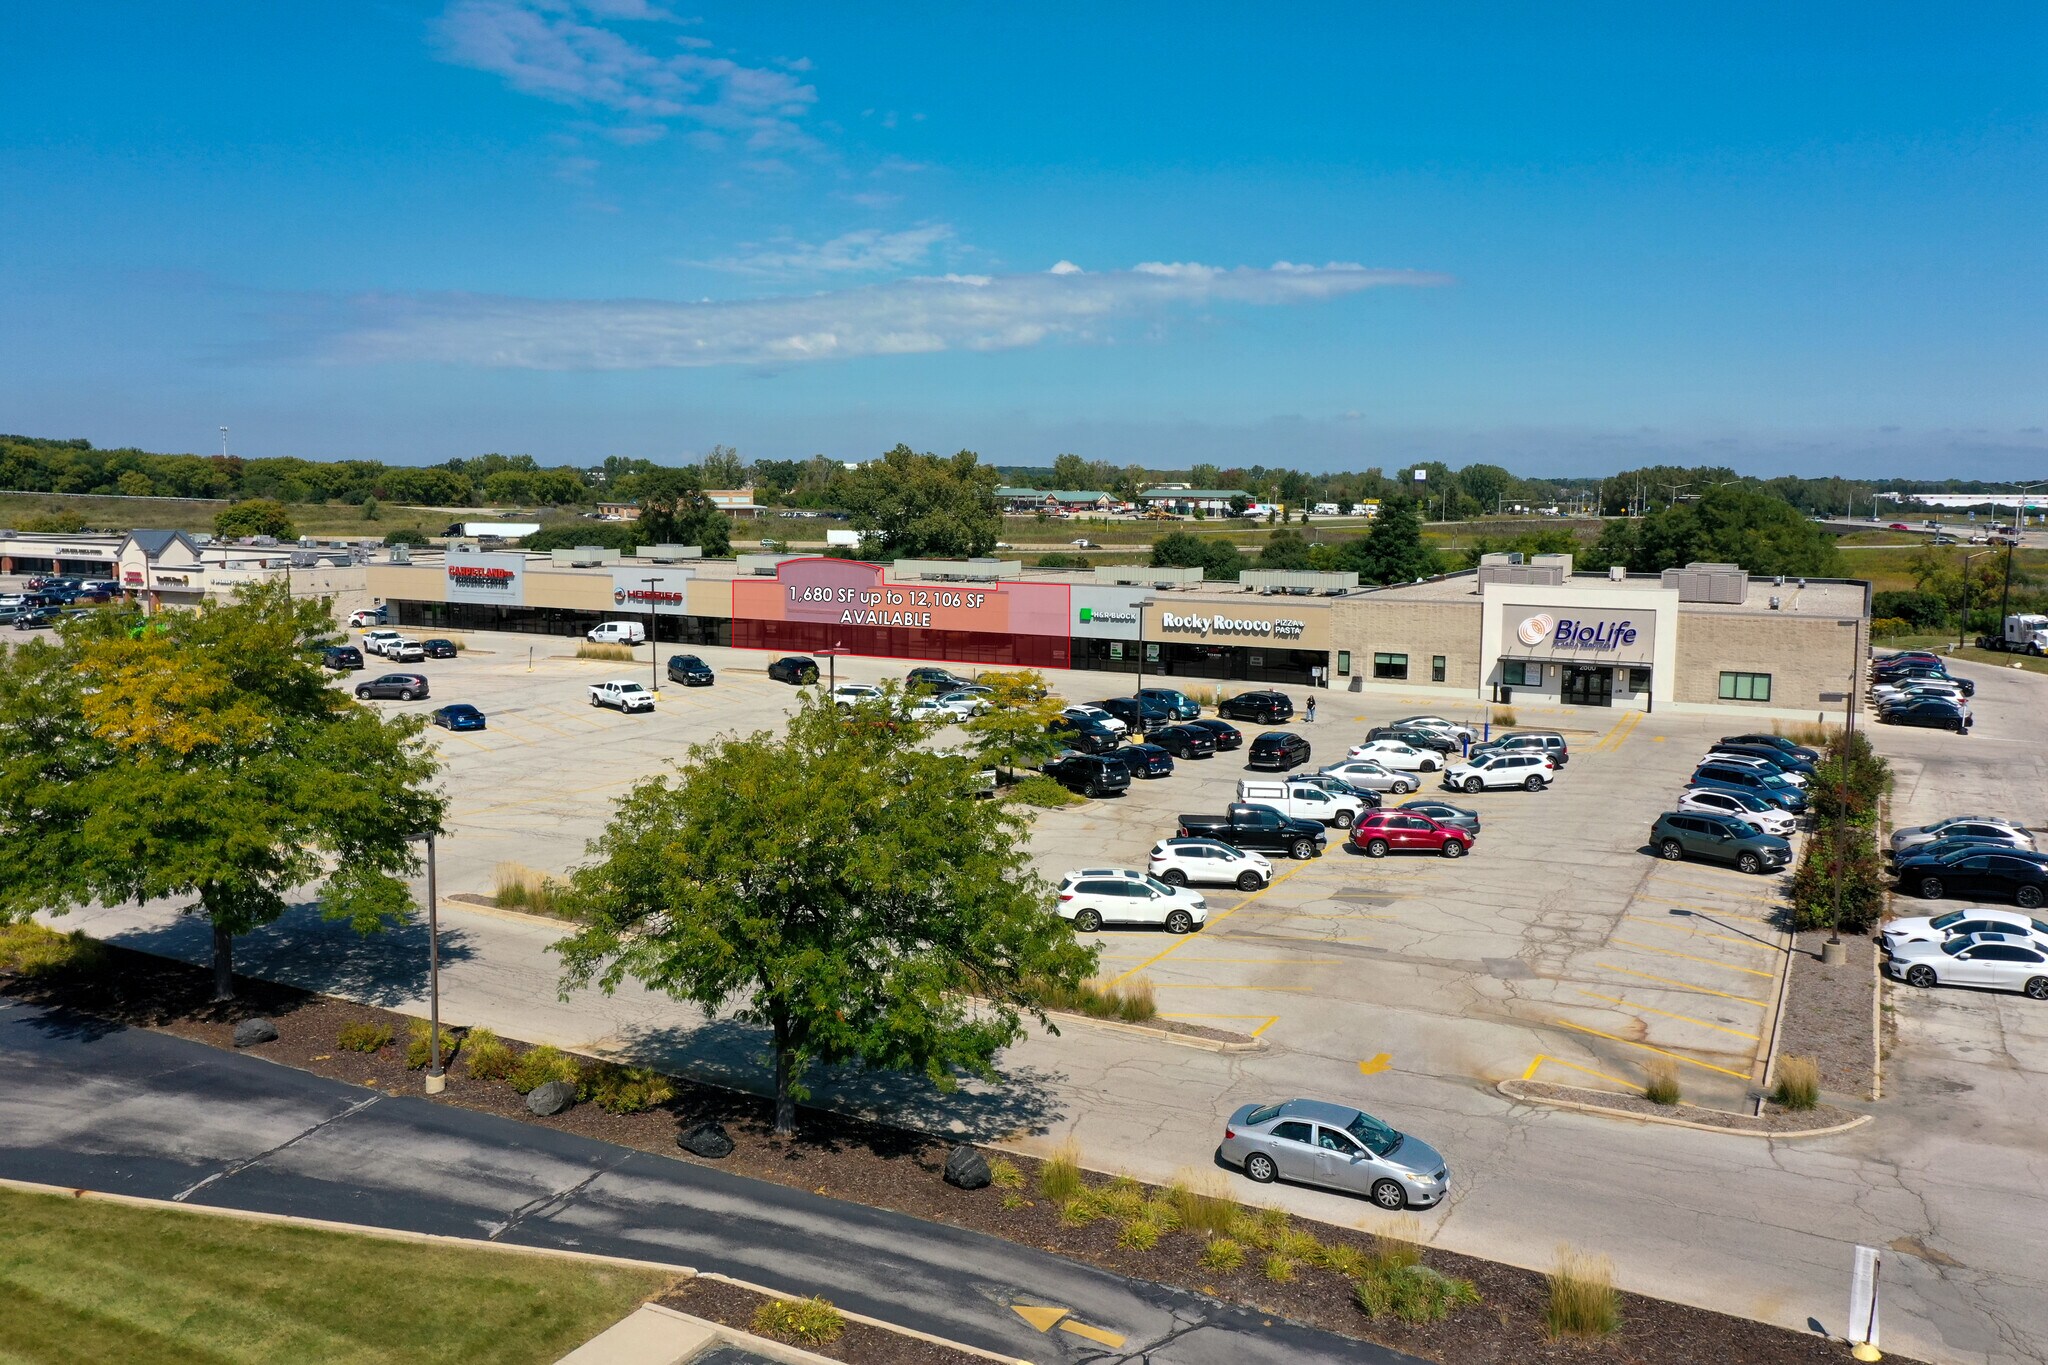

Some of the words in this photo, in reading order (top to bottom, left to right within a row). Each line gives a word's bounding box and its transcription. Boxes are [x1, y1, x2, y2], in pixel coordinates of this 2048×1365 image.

[448, 565, 504, 578] CARPETLAND
[627, 590, 683, 602] HOBBIES
[1110, 612, 1136, 620] BLOCK
[1163, 612, 1212, 632] Rocky
[1213, 615, 1272, 632] Rococo
[1275, 618, 1299, 627] PIZZA
[1275, 626, 1302, 634] PASTA
[1555, 619, 1637, 648] BioLife
